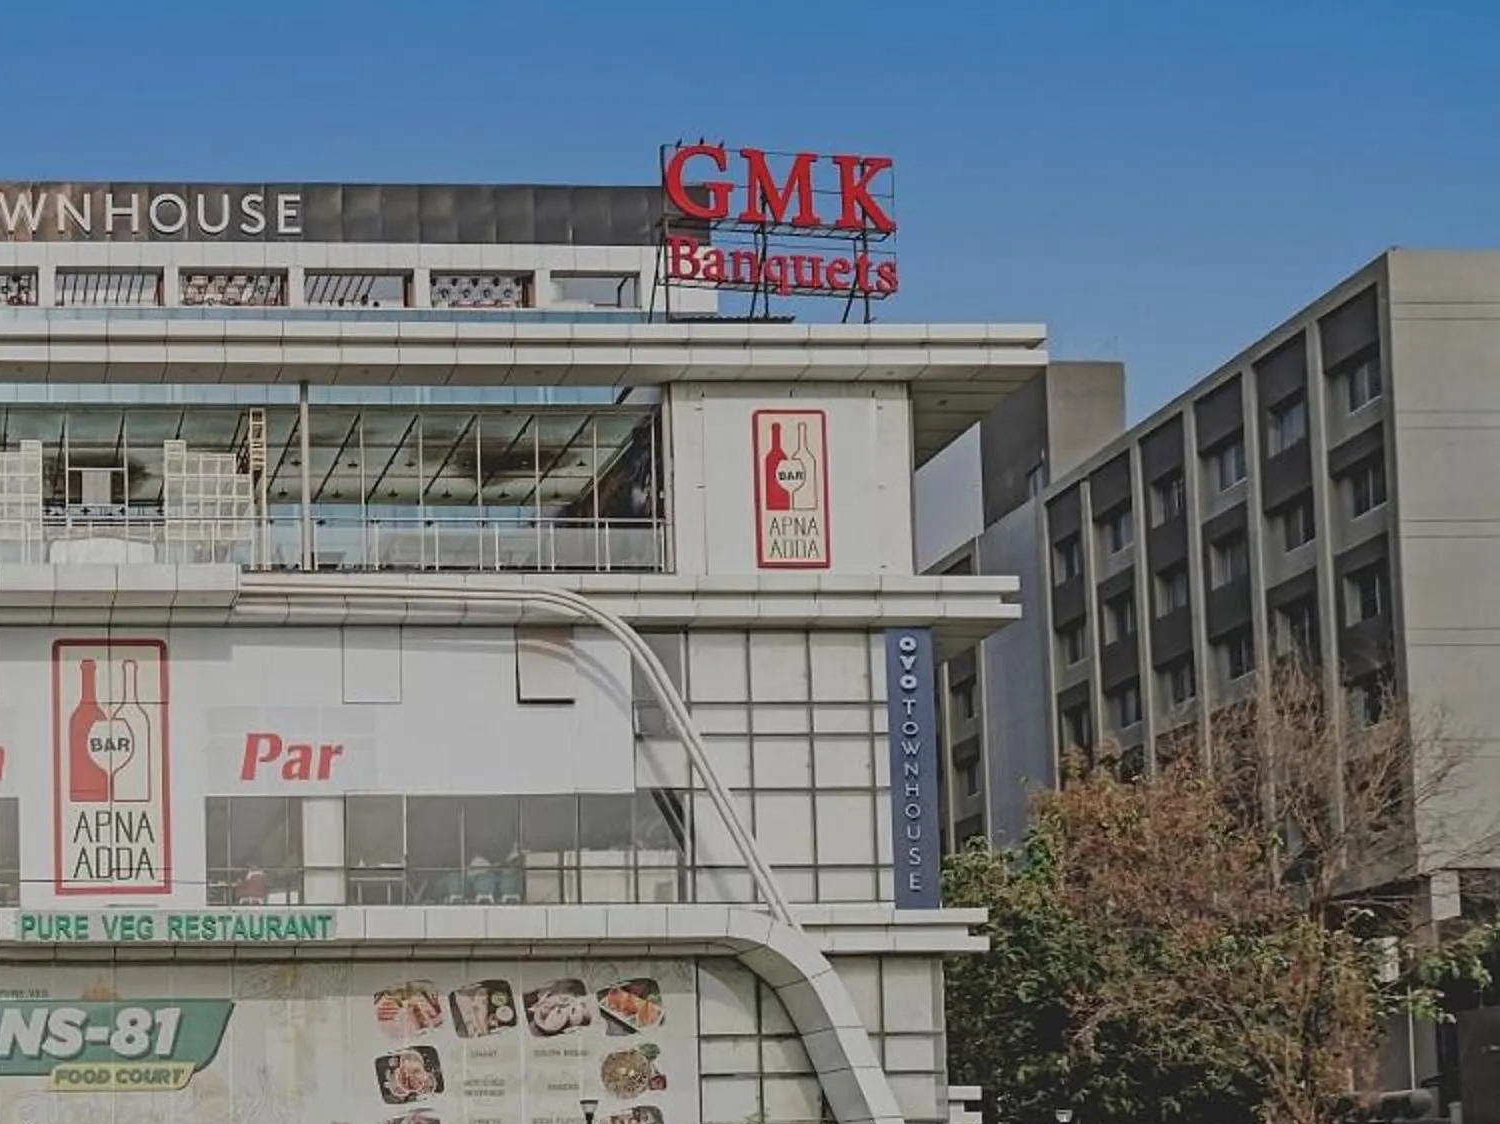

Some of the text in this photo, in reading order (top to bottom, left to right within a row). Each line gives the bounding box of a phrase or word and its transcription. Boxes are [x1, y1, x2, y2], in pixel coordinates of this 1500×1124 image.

[665, 143, 896, 232] GMK
[666, 234, 898, 297] Banquets
[770, 516, 819, 536] APNA
[90, 737, 131, 752] BAR
[240, 733, 344, 781] Par
[899, 636, 921, 893] OYO TOWNHOUSE
[73, 810, 155, 844] APNA
[73, 846, 155, 880] ADDA
[21, 915, 333, 940] PURE VEG RESTAURANT
[54, 1069, 186, 1085] FOOD COURT
